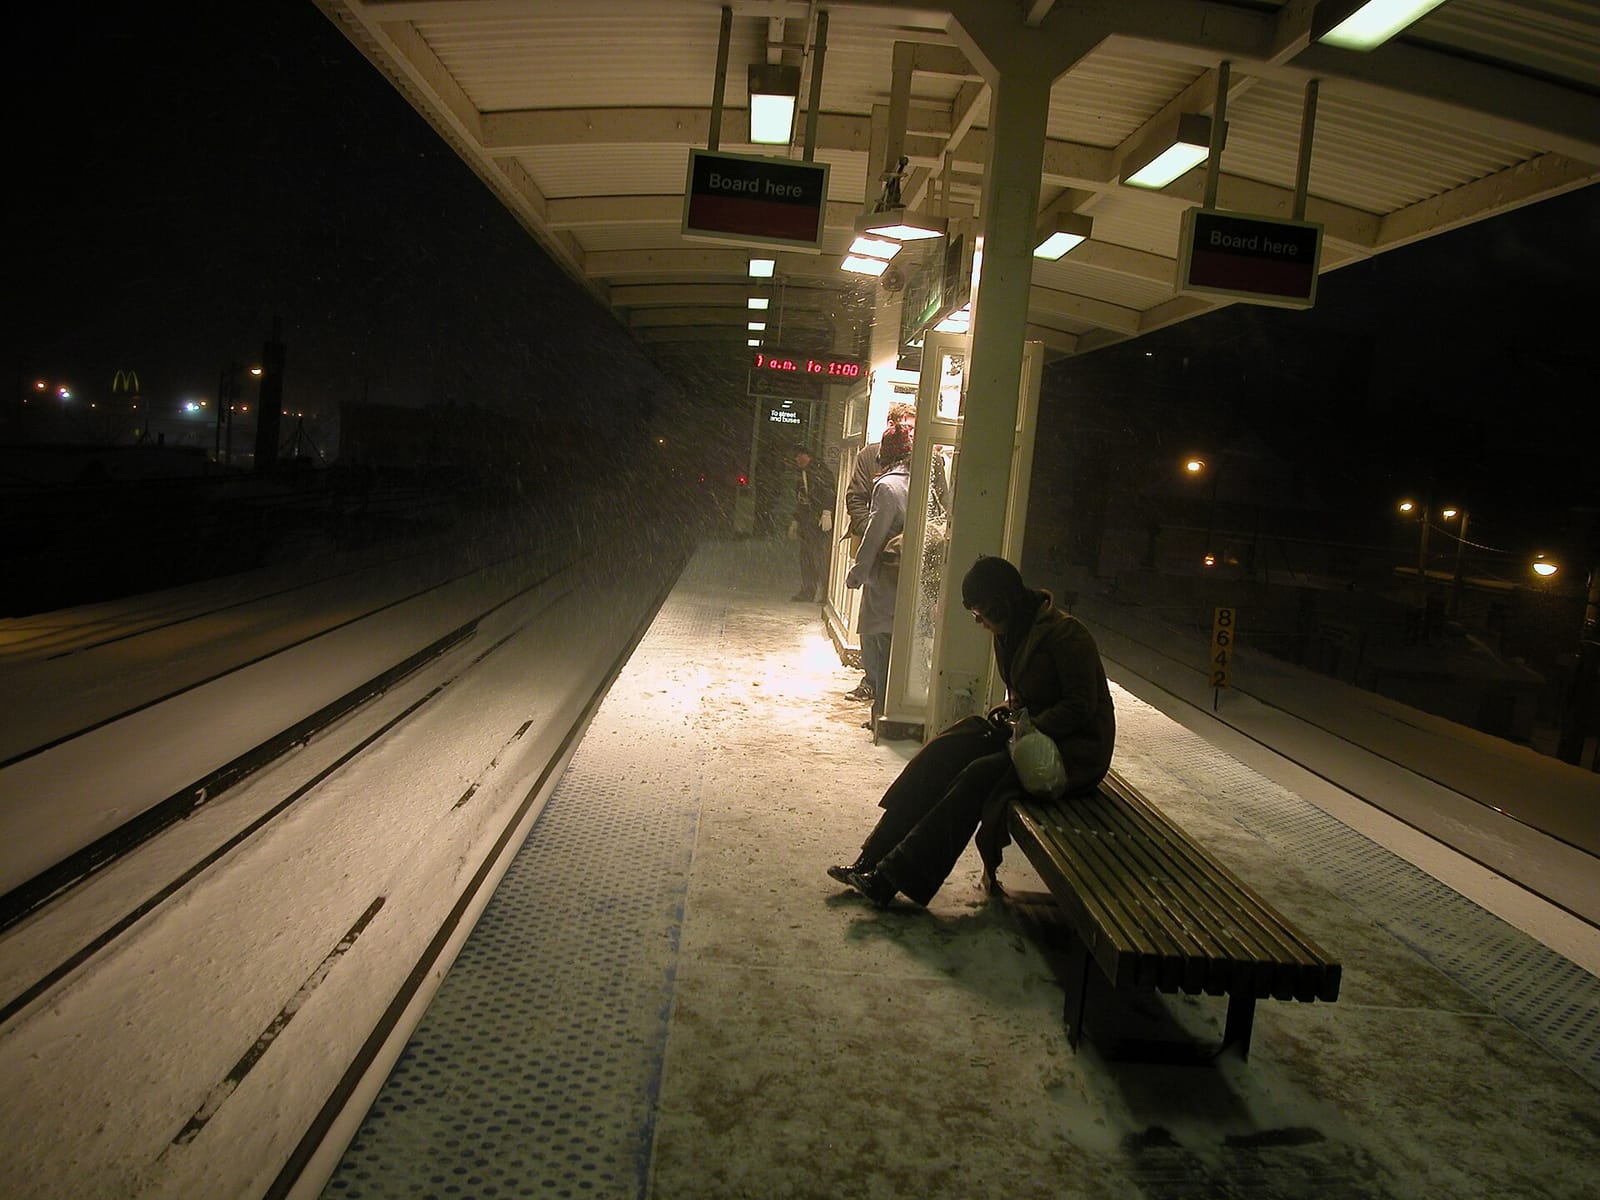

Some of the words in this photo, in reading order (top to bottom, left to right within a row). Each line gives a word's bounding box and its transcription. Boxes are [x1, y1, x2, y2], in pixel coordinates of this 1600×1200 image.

[708, 173, 759, 193] Board
[765, 179, 802, 198] here
[1210, 230, 1258, 250] Board
[1263, 237, 1298, 256] here
[828, 362, 859, 377] 1:00
[769, 415, 781, 423] and
[782, 416, 801, 424] buses
[771, 409, 779, 417] To
[779, 410, 797, 418] street
